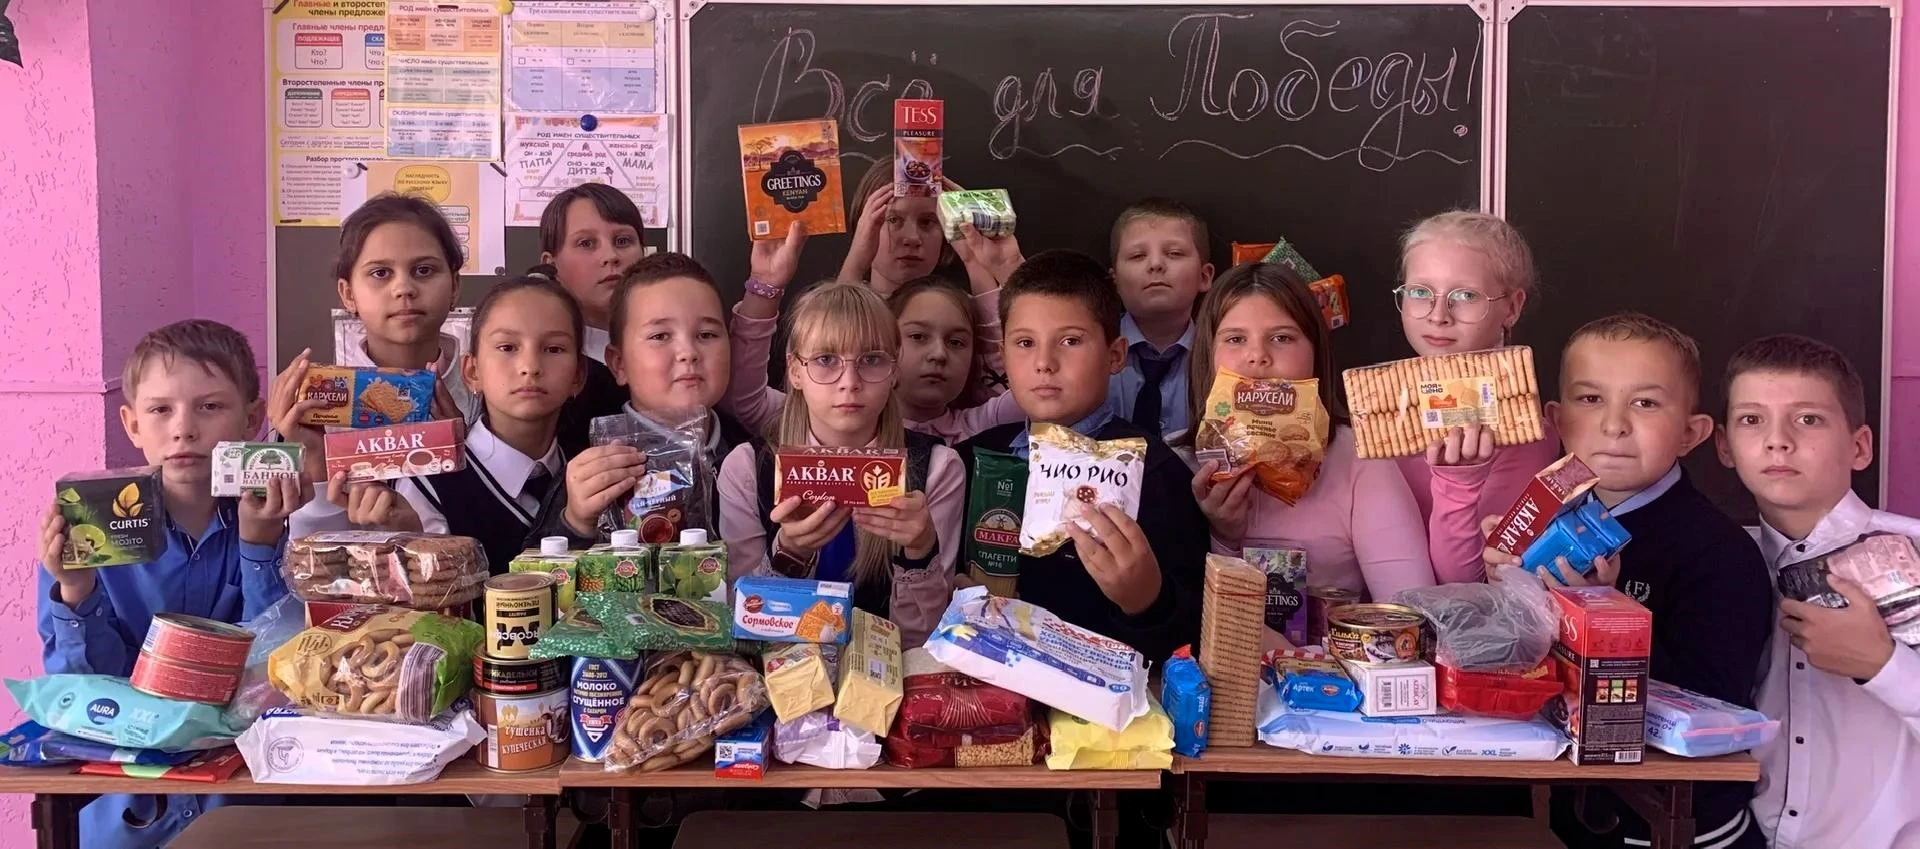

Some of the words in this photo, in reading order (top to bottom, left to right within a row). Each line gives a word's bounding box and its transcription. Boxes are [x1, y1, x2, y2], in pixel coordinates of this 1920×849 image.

[282, 79, 346, 87] Второстепенные
[902, 106, 937, 124] TESS
[520, 158, 553, 169] ПАПА
[623, 158, 654, 170] МАМА
[567, 167, 597, 176] ДИТЯ
[767, 174, 822, 191] GREETINGS
[782, 188, 809, 197] KENYAN
[307, 391, 348, 402] КАРУСЕЛИ
[1237, 391, 1294, 406] КАРУСЕЛИ
[355, 433, 425, 454] AKBAR
[803, 447, 880, 455] AKBAR
[243, 471, 297, 480] БАННОЕ
[787, 465, 855, 482] AKBAR
[1040, 463, 1081, 480] ЧИО
[1088, 466, 1128, 487] РИО
[997, 480, 1014, 491] №1
[802, 489, 836, 504] Ceylon
[109, 518, 149, 531] CURTIS
[1500, 497, 1541, 548] AKBAR
[111, 537, 144, 547] MOJITO
[978, 550, 1017, 563] СПАГЕТТИ
[742, 615, 794, 628] Сормовское
[1564, 614, 1578, 642] SS
[576, 681, 617, 691] МОЛОКО
[573, 695, 625, 708] СГУЩЁННОЕ
[90, 704, 115, 716] AURA
